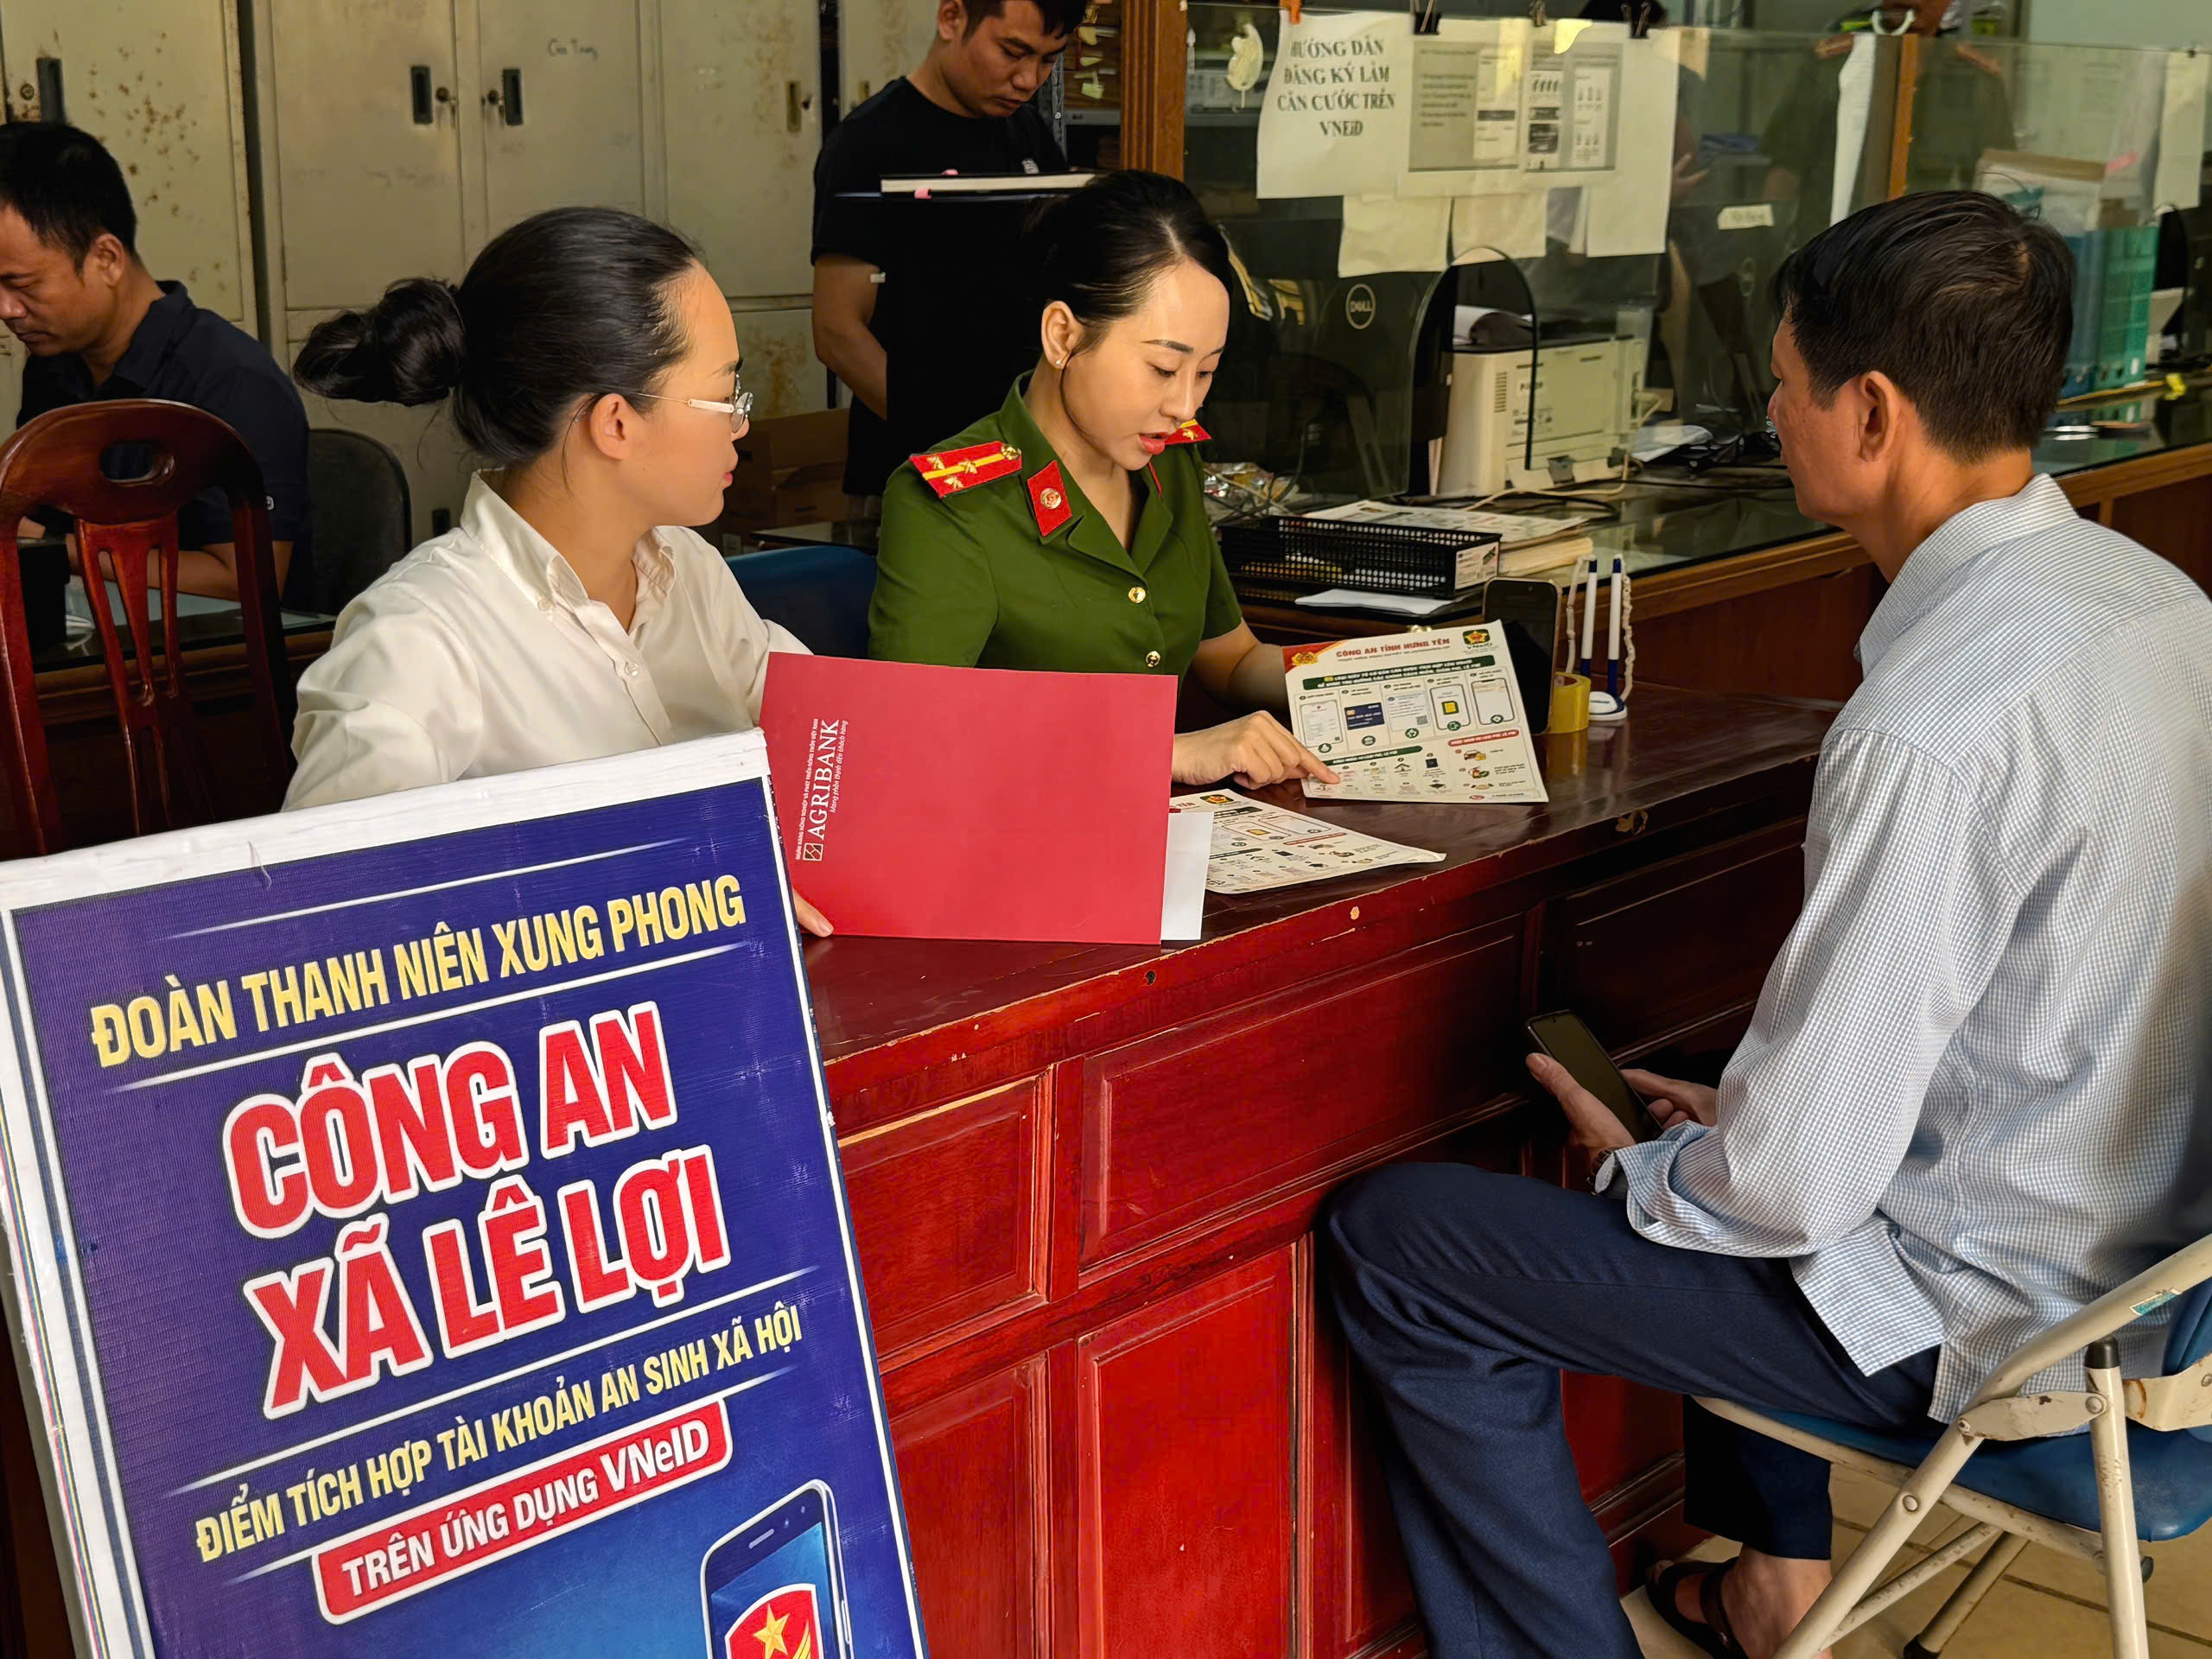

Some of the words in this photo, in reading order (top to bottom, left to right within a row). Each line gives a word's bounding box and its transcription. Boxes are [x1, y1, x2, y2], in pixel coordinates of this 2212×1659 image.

[1277, 91, 1307, 111] CĂN
[1312, 88, 1360, 111] CƯỚC
[1363, 86, 1395, 110] TRÊN
[1284, 63, 1326, 85] ĐĂNG
[1332, 60, 1355, 83] KÝ
[1360, 60, 1389, 83] LÀM
[1290, 37, 1347, 58] HƯỚNG
[1351, 35, 1384, 55] DẪN
[1350, 300, 1373, 312] DELL
[807, 719, 840, 841] AGRIBANK
[91, 976, 235, 1068] ĐOÀN
[242, 950, 389, 1033] THANH
[395, 921, 488, 1000] NIÊN
[493, 899, 604, 977] XUNG
[608, 874, 746, 952] PHONG
[226, 1057, 526, 1235] CÔNG
[543, 1006, 675, 1154] AN
[249, 1219, 429, 1413] XÃ
[426, 1180, 563, 1354] LÊ
[560, 1149, 729, 1307] LỢI
[195, 1482, 284, 1563] ĐIỂM
[287, 1460, 362, 1526] TÍCH
[367, 1441, 431, 1499] HỢP
[437, 1416, 487, 1469] TÀI
[492, 1376, 595, 1452] KHOẢN
[602, 1364, 639, 1412] AN
[644, 1339, 709, 1395] SINH
[712, 1315, 753, 1370] XÃ
[756, 1300, 801, 1351] HỘI
[342, 1532, 435, 1597] TRÊN
[440, 1497, 510, 1559] ỨNG
[513, 1468, 599, 1532] DỤNG
[600, 1419, 710, 1492] VNeID
